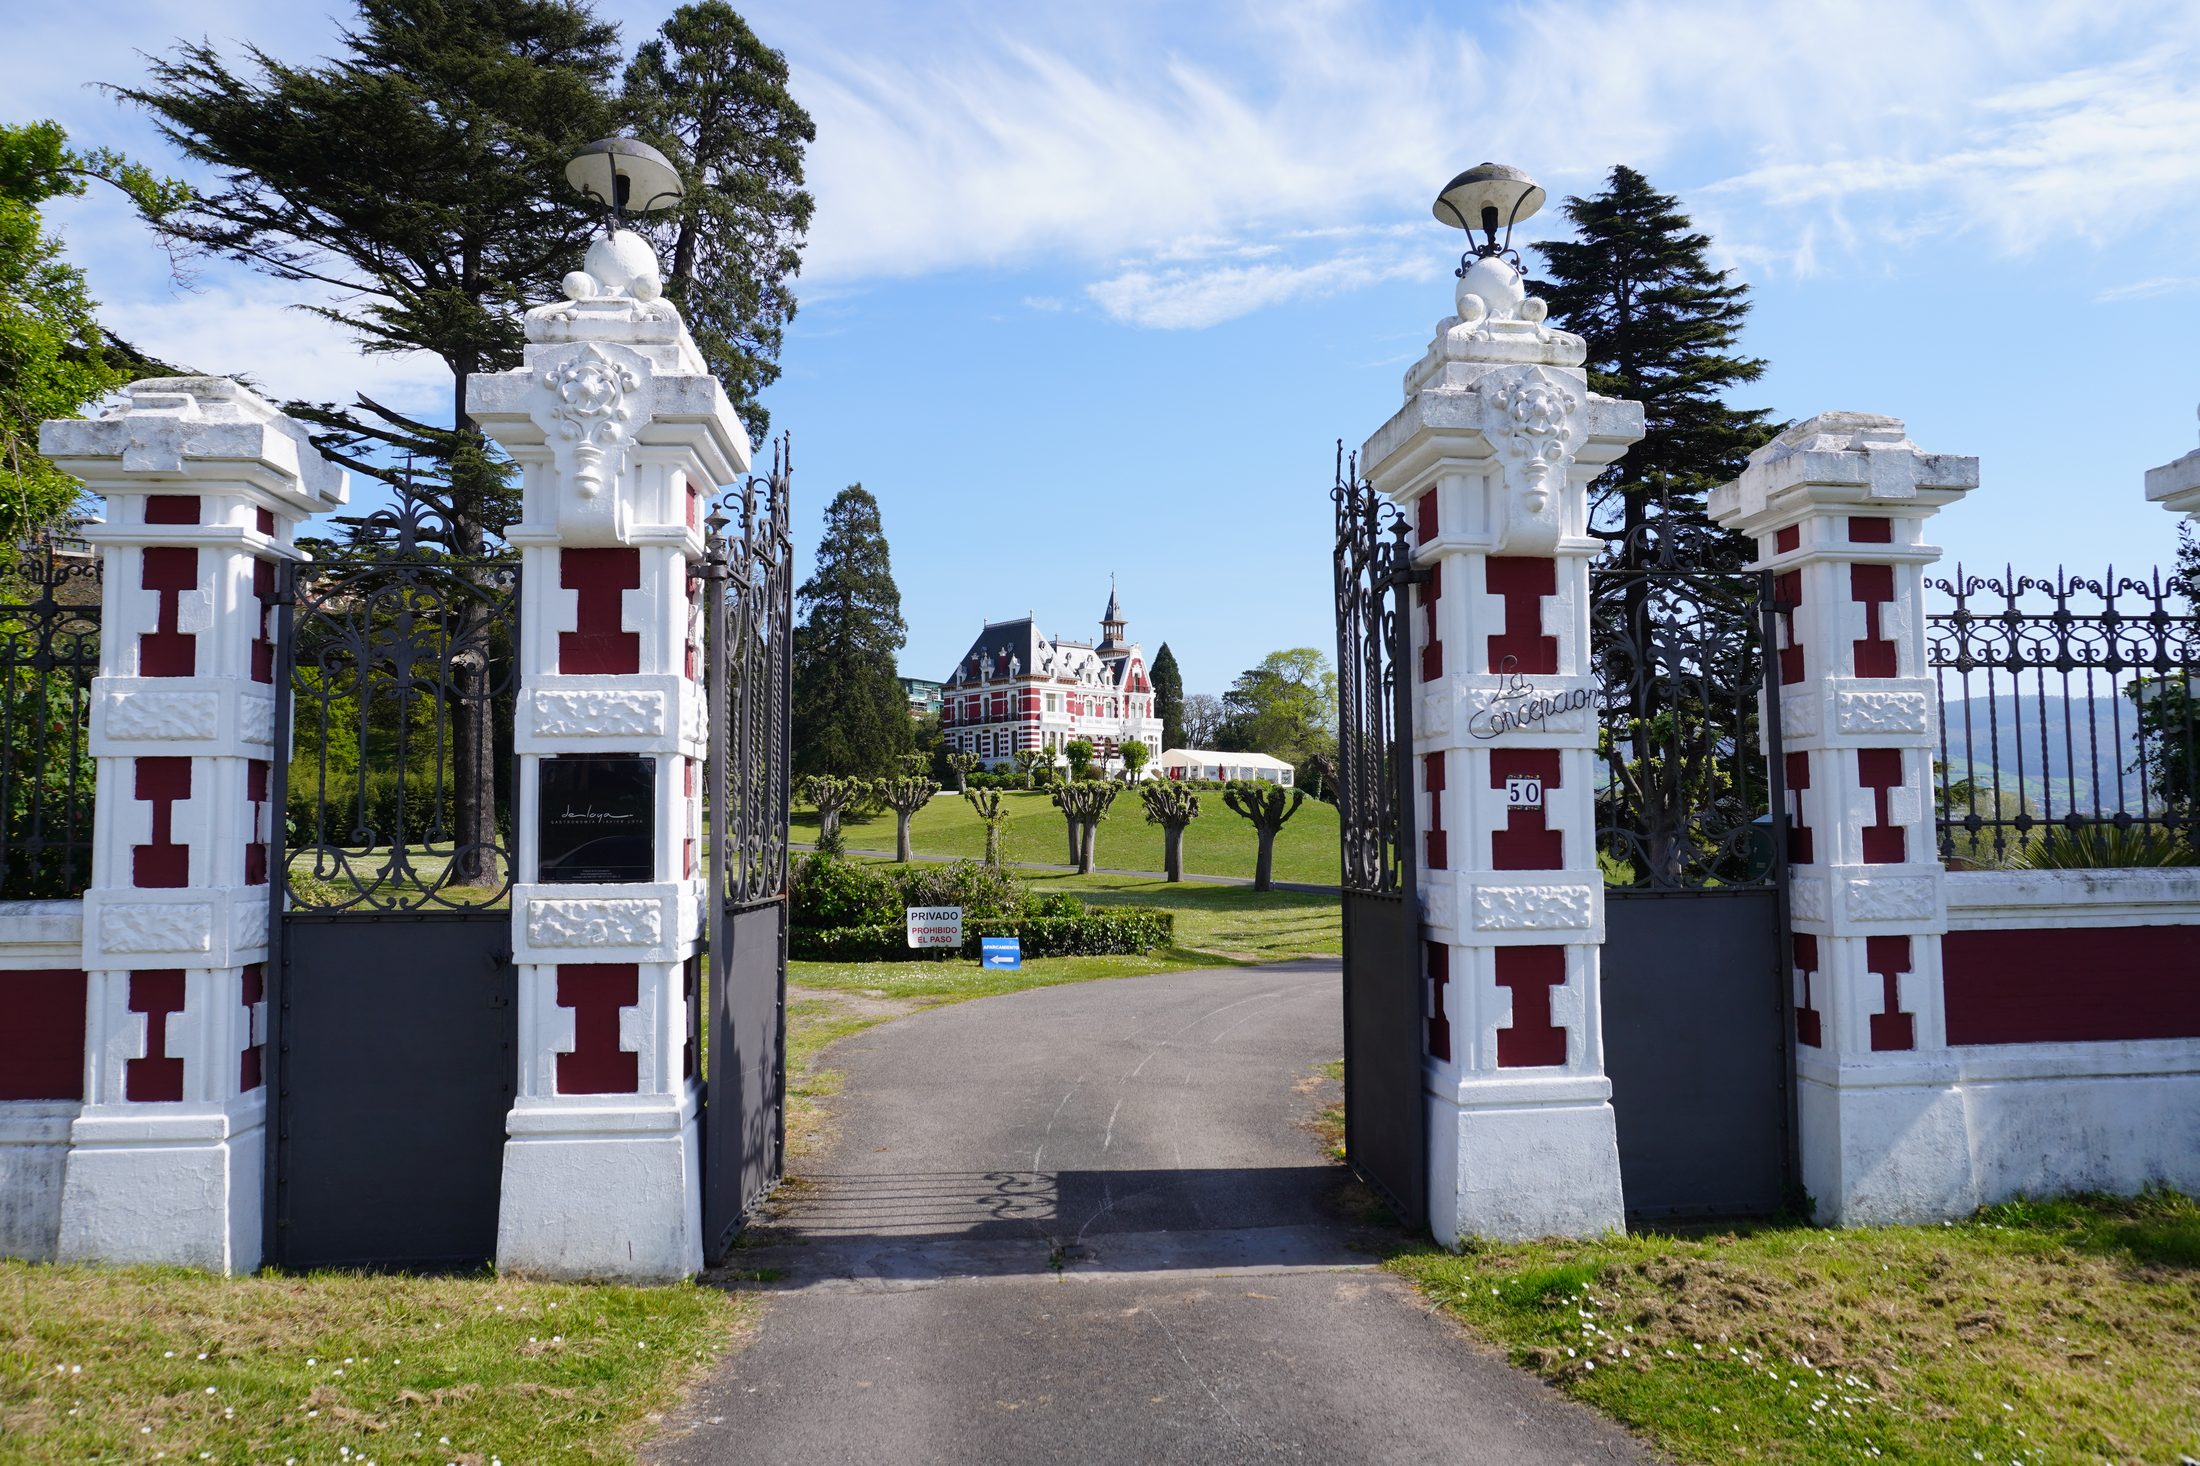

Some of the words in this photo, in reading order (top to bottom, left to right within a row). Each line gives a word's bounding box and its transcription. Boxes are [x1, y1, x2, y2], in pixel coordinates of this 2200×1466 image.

[1491, 655, 1534, 704] La
[1510, 782, 1539, 802] 50
[911, 911, 959, 921] PRIVADO
